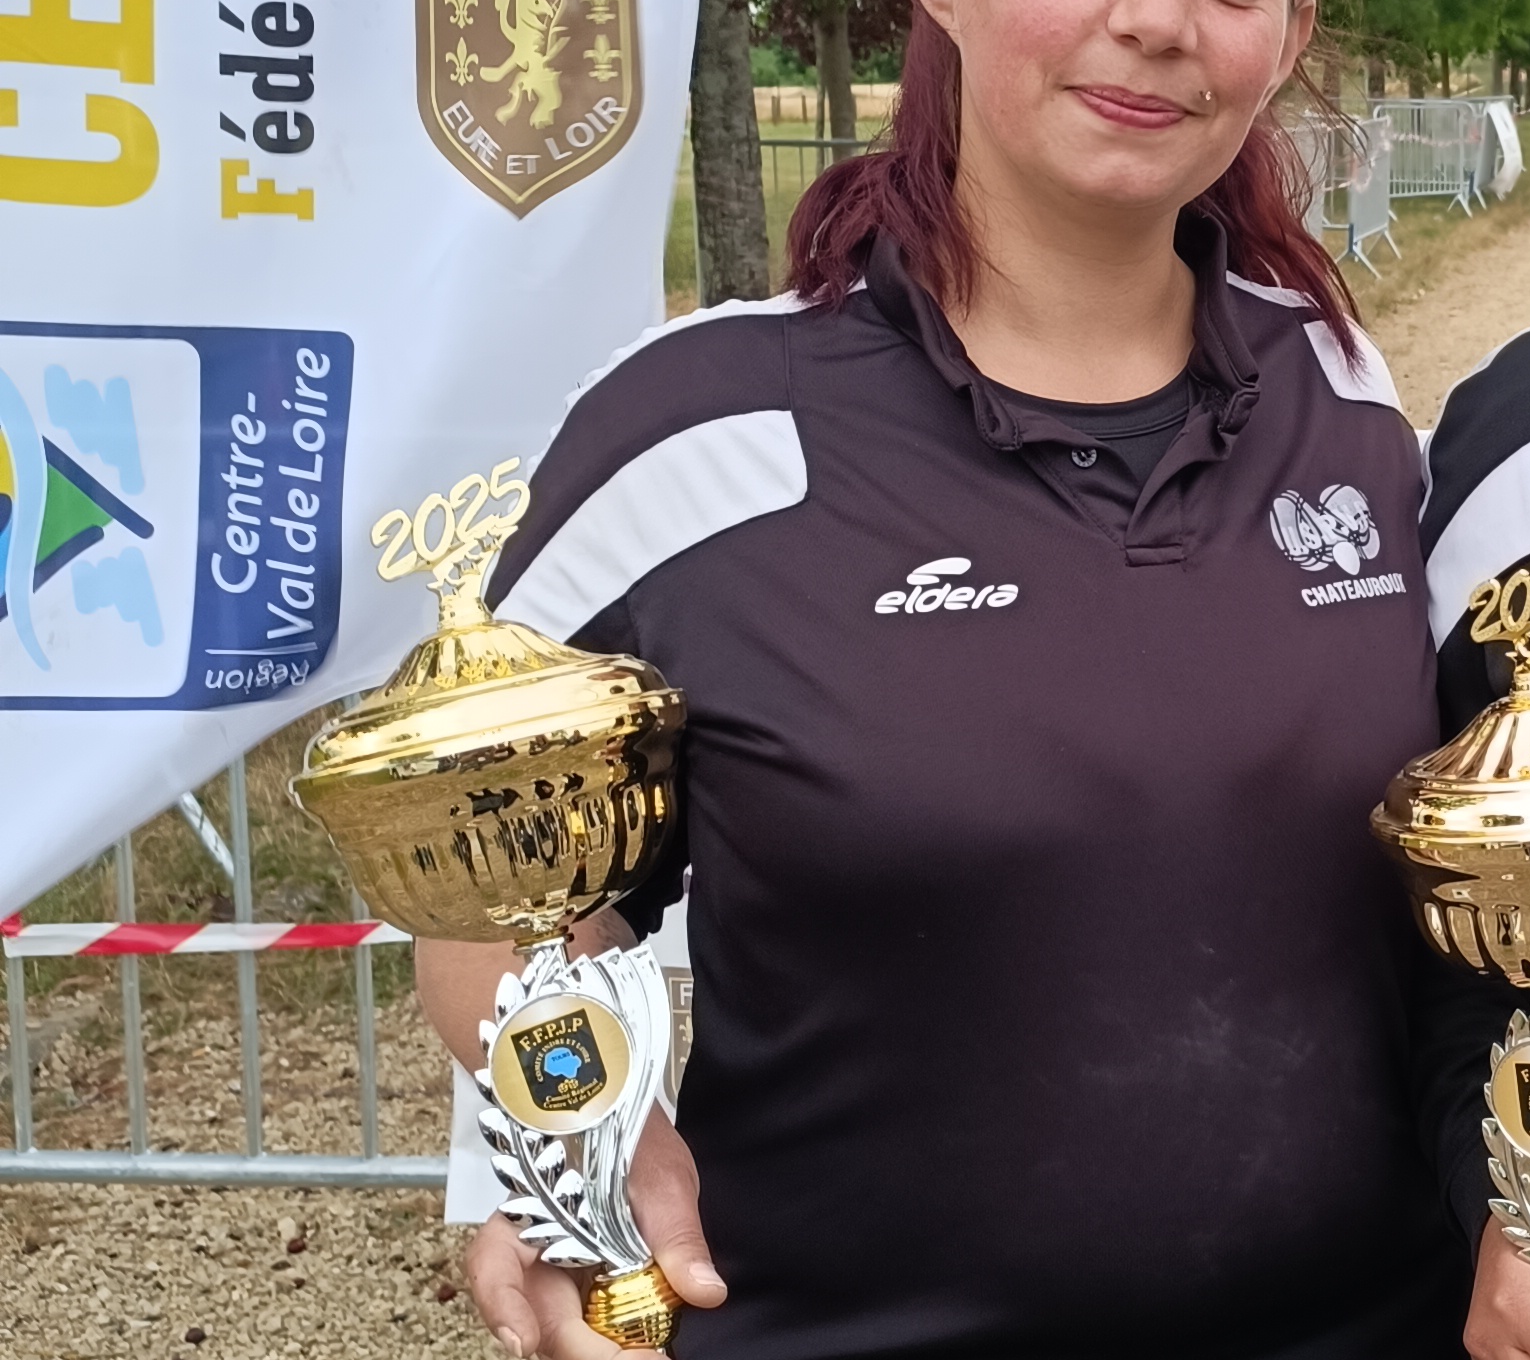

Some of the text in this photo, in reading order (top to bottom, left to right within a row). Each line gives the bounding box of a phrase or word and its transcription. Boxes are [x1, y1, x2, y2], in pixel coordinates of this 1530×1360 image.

[506, 154, 541, 175] ET
[544, 96, 628, 161] LOIR
[211, 392, 266, 593] Centre-
[371, 456, 531, 582] 2025
[874, 584, 1018, 615] eldera
[519, 1017, 583, 1052] F.F.P.J.P
